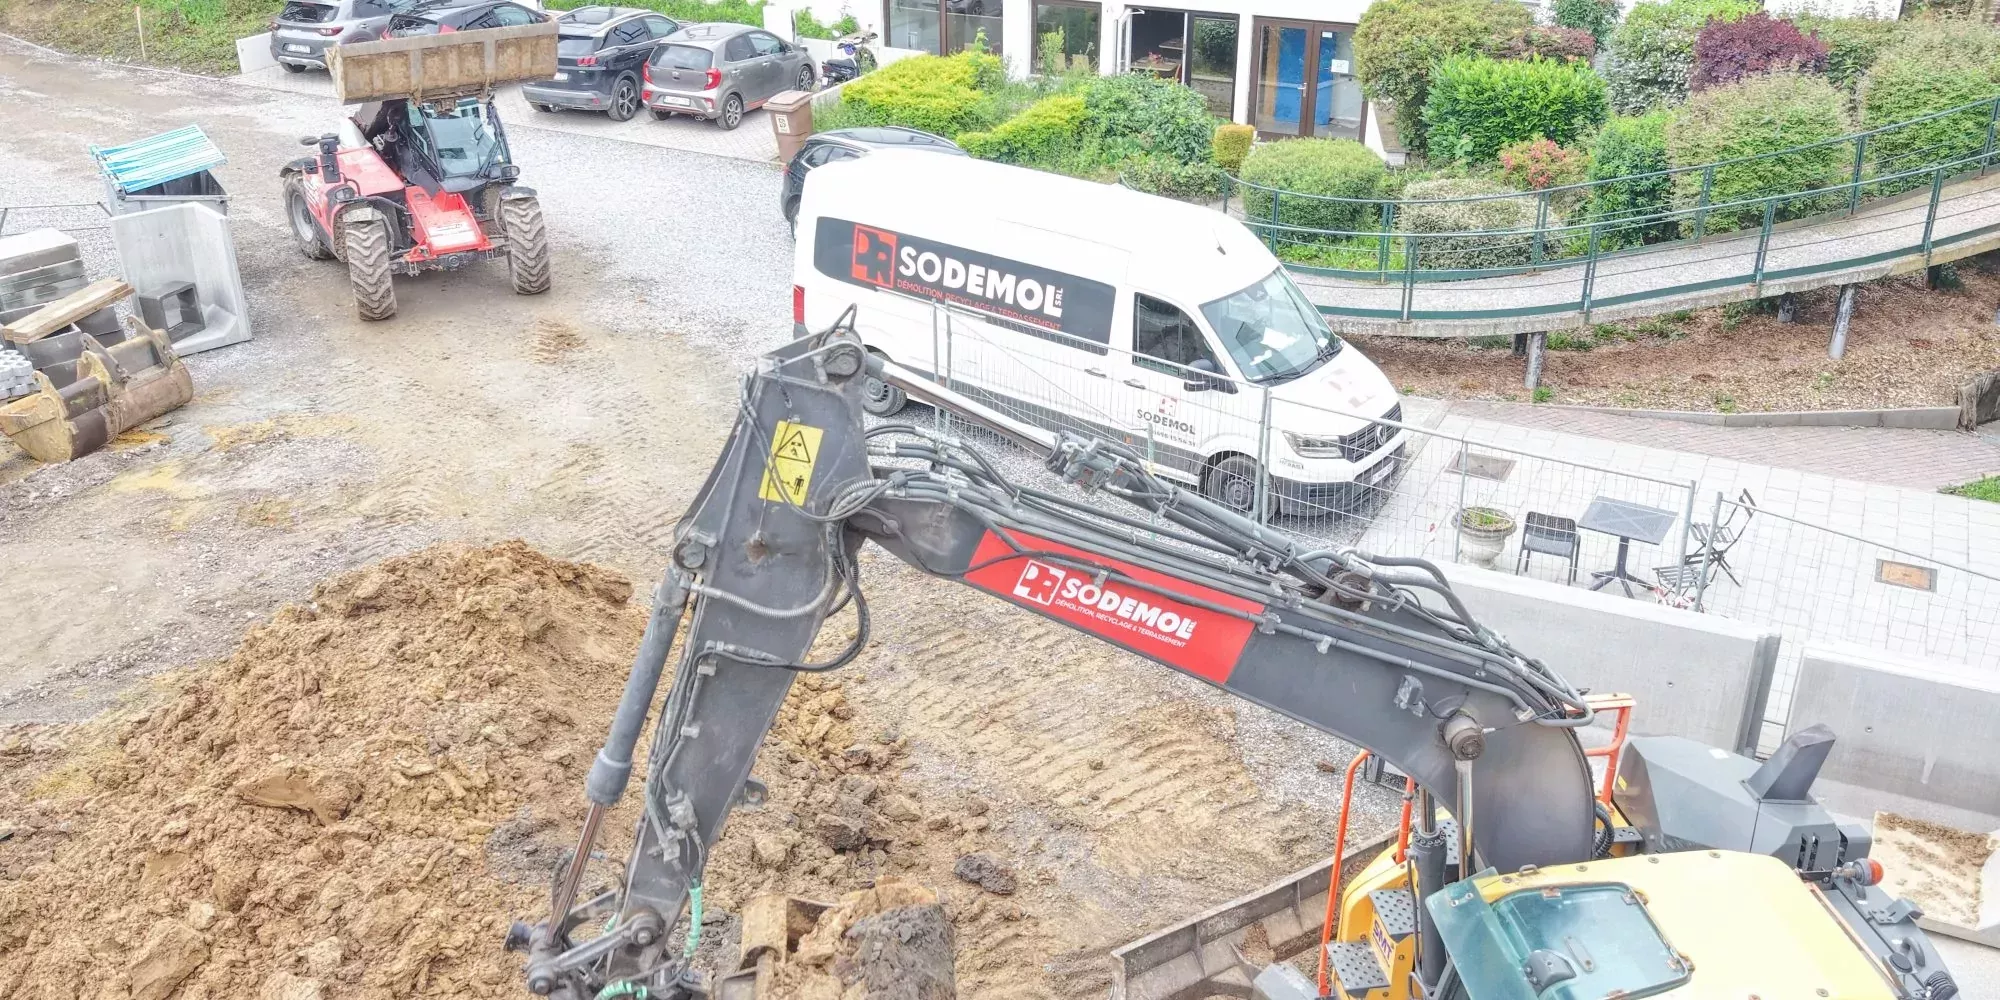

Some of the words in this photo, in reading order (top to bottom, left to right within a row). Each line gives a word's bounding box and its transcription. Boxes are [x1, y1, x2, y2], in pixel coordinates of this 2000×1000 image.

[898, 245, 1063, 318] SODEMOL
[1054, 287, 1064, 306] SRL
[1137, 408, 1196, 436] SODEMOL
[1060, 577, 1193, 641] SODEMOL
[1095, 612, 1133, 631] RECYCLAGE
[1137, 626, 1187, 649] TERRASSEMENT
[1373, 919, 1392, 961] SMT
